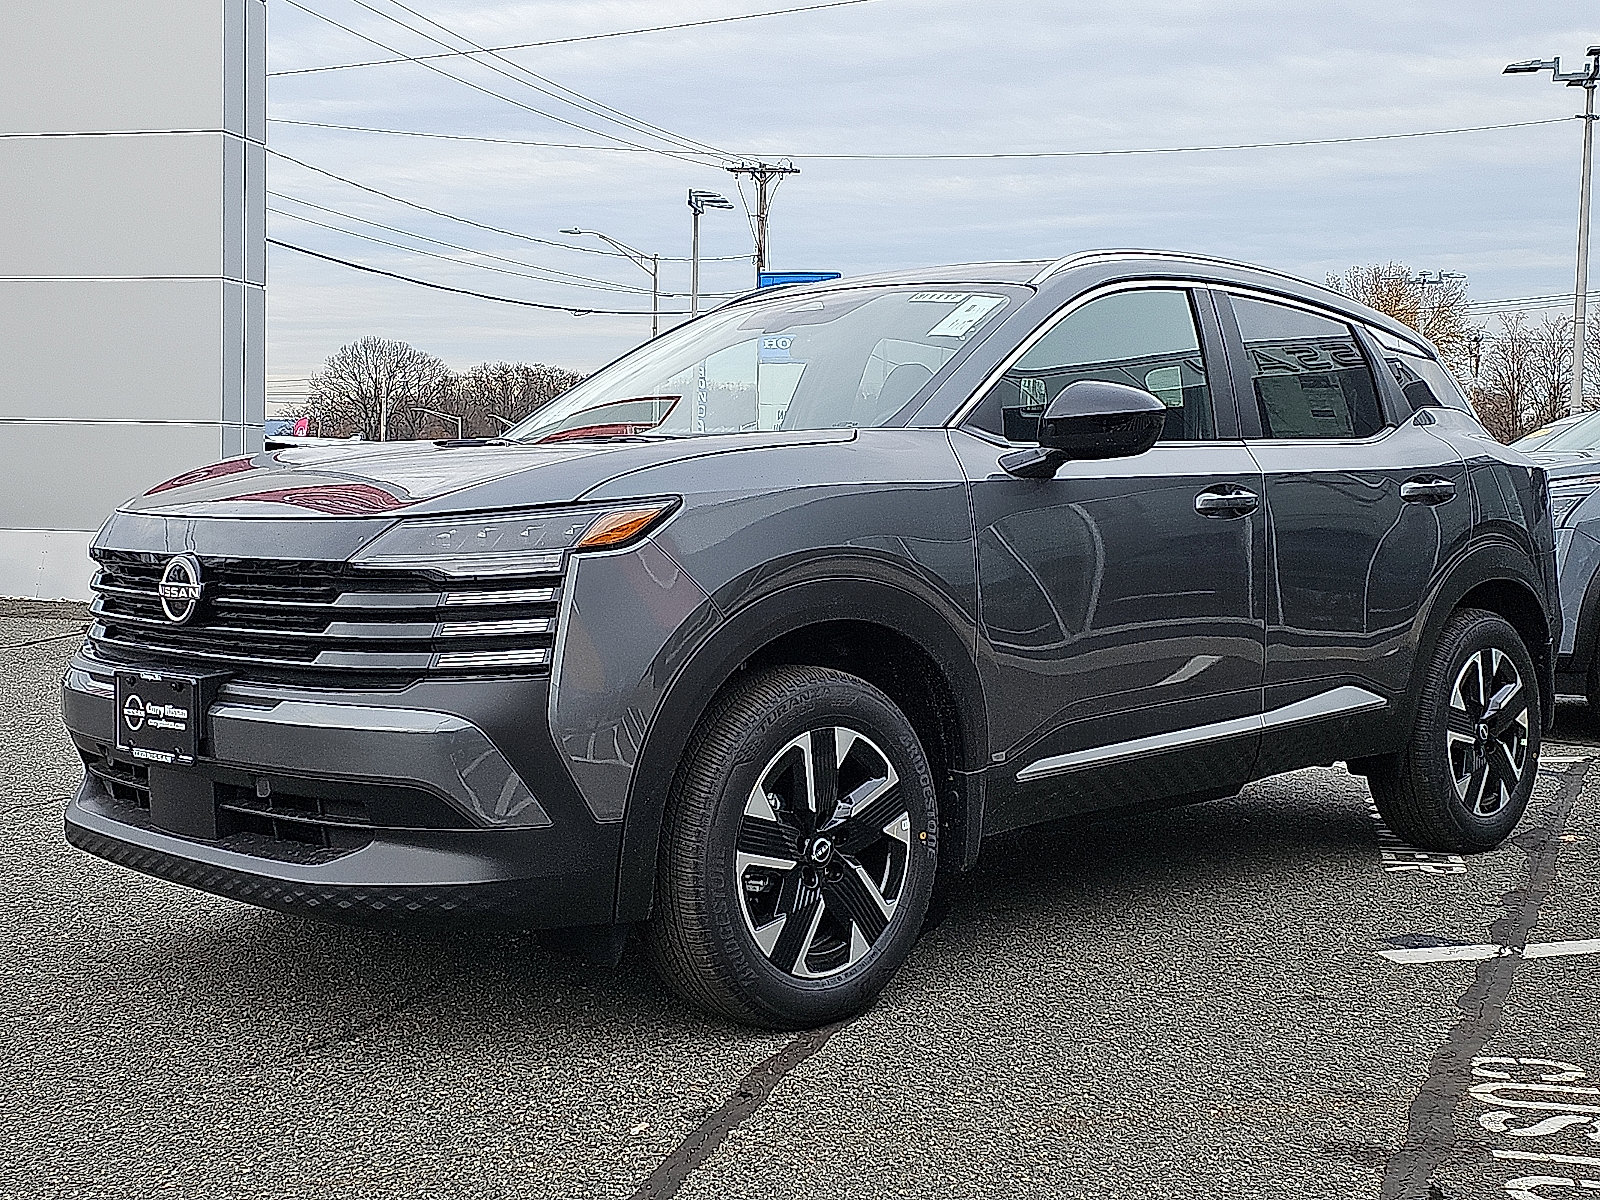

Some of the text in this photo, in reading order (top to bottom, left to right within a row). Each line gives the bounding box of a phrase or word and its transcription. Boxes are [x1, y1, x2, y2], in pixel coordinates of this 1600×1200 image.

[763, 337, 793, 350] HO
[160, 585, 200, 599] NISSAN
[146, 702, 188, 719] Curry Nissan
[898, 733, 938, 859] BRIDGESTONE
